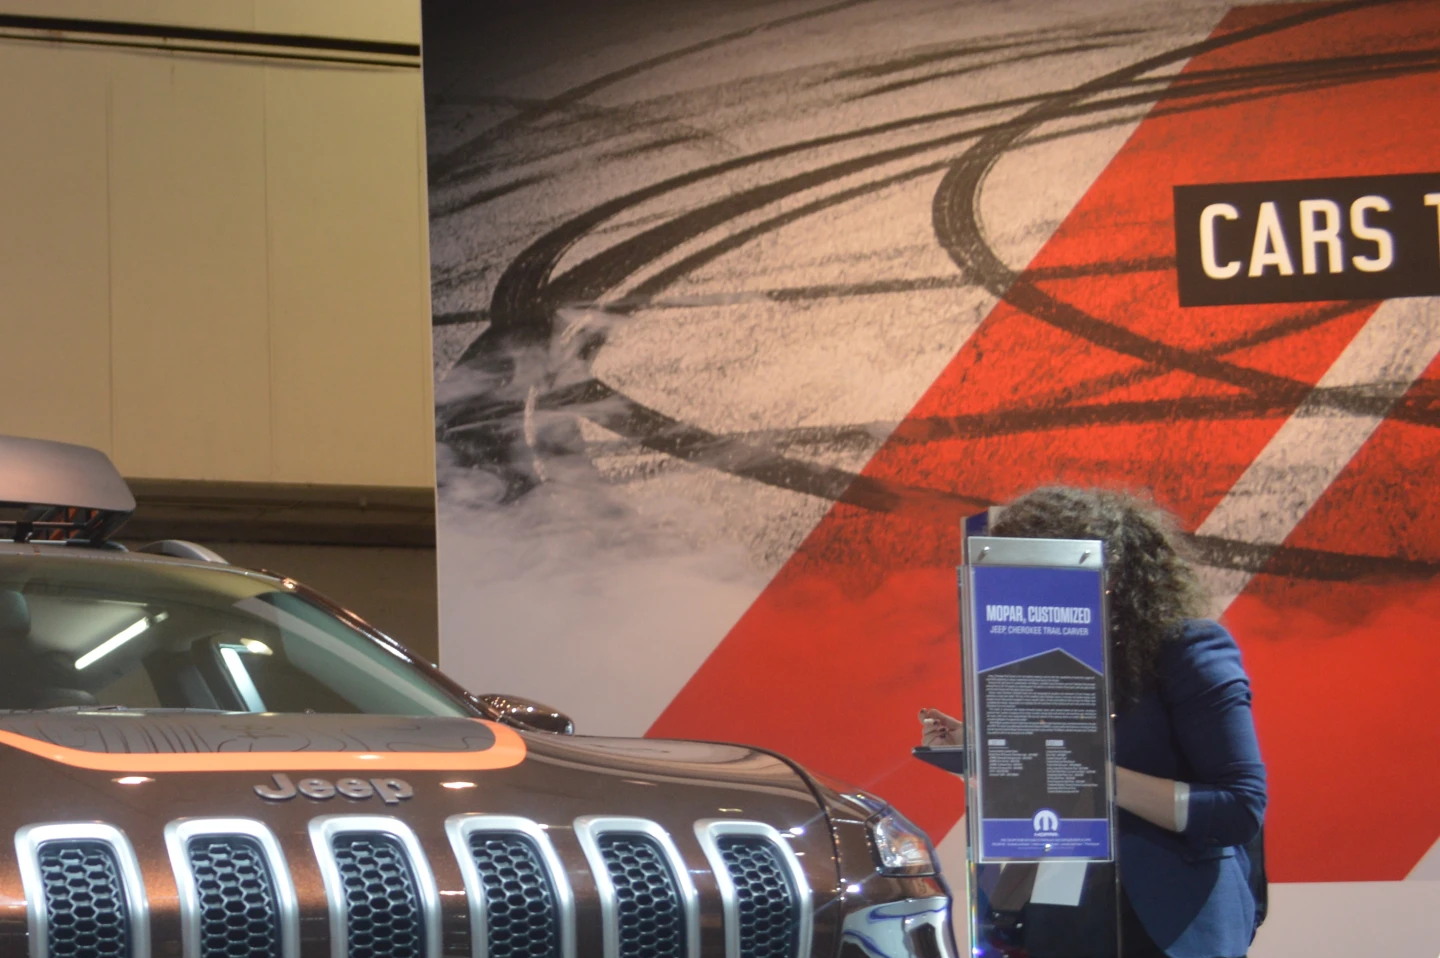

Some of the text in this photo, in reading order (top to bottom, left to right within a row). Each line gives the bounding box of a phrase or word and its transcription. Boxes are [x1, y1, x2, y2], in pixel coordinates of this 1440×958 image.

[1199, 195, 1395, 280] CARS
[986, 605, 1091, 624] MOPAR, CUSTOMIZED
[1007, 626, 1042, 635] CHEROKEE
[1043, 627, 1062, 635] TRAIL
[1063, 628, 1089, 636] CARVER
[253, 773, 414, 804] Jeep
